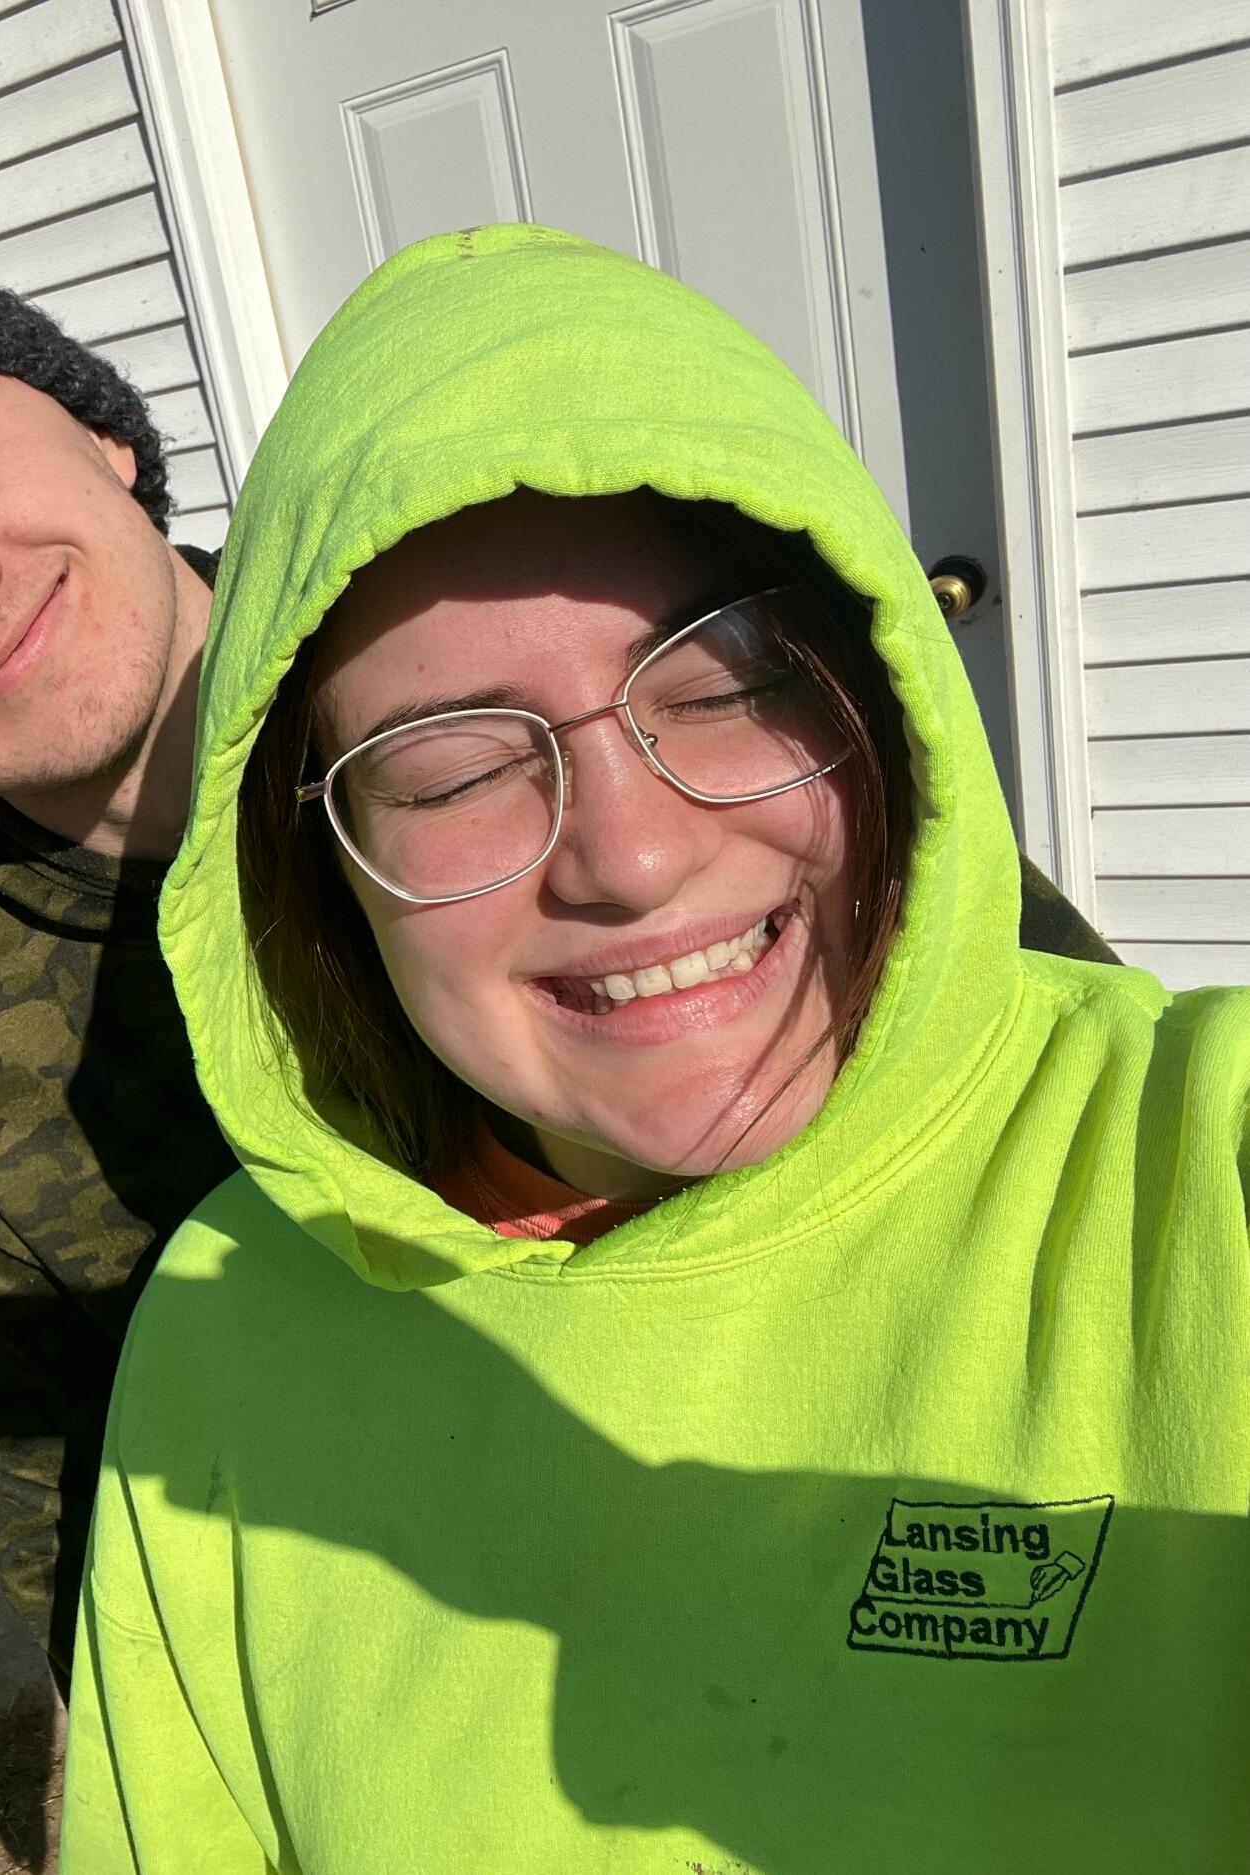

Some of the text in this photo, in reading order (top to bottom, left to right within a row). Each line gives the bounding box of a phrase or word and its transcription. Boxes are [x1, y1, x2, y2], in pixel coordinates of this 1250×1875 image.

[885, 1512, 1050, 1560] Lansing
[871, 1555, 986, 1597] Glass
[851, 1600, 1050, 1656] Company
